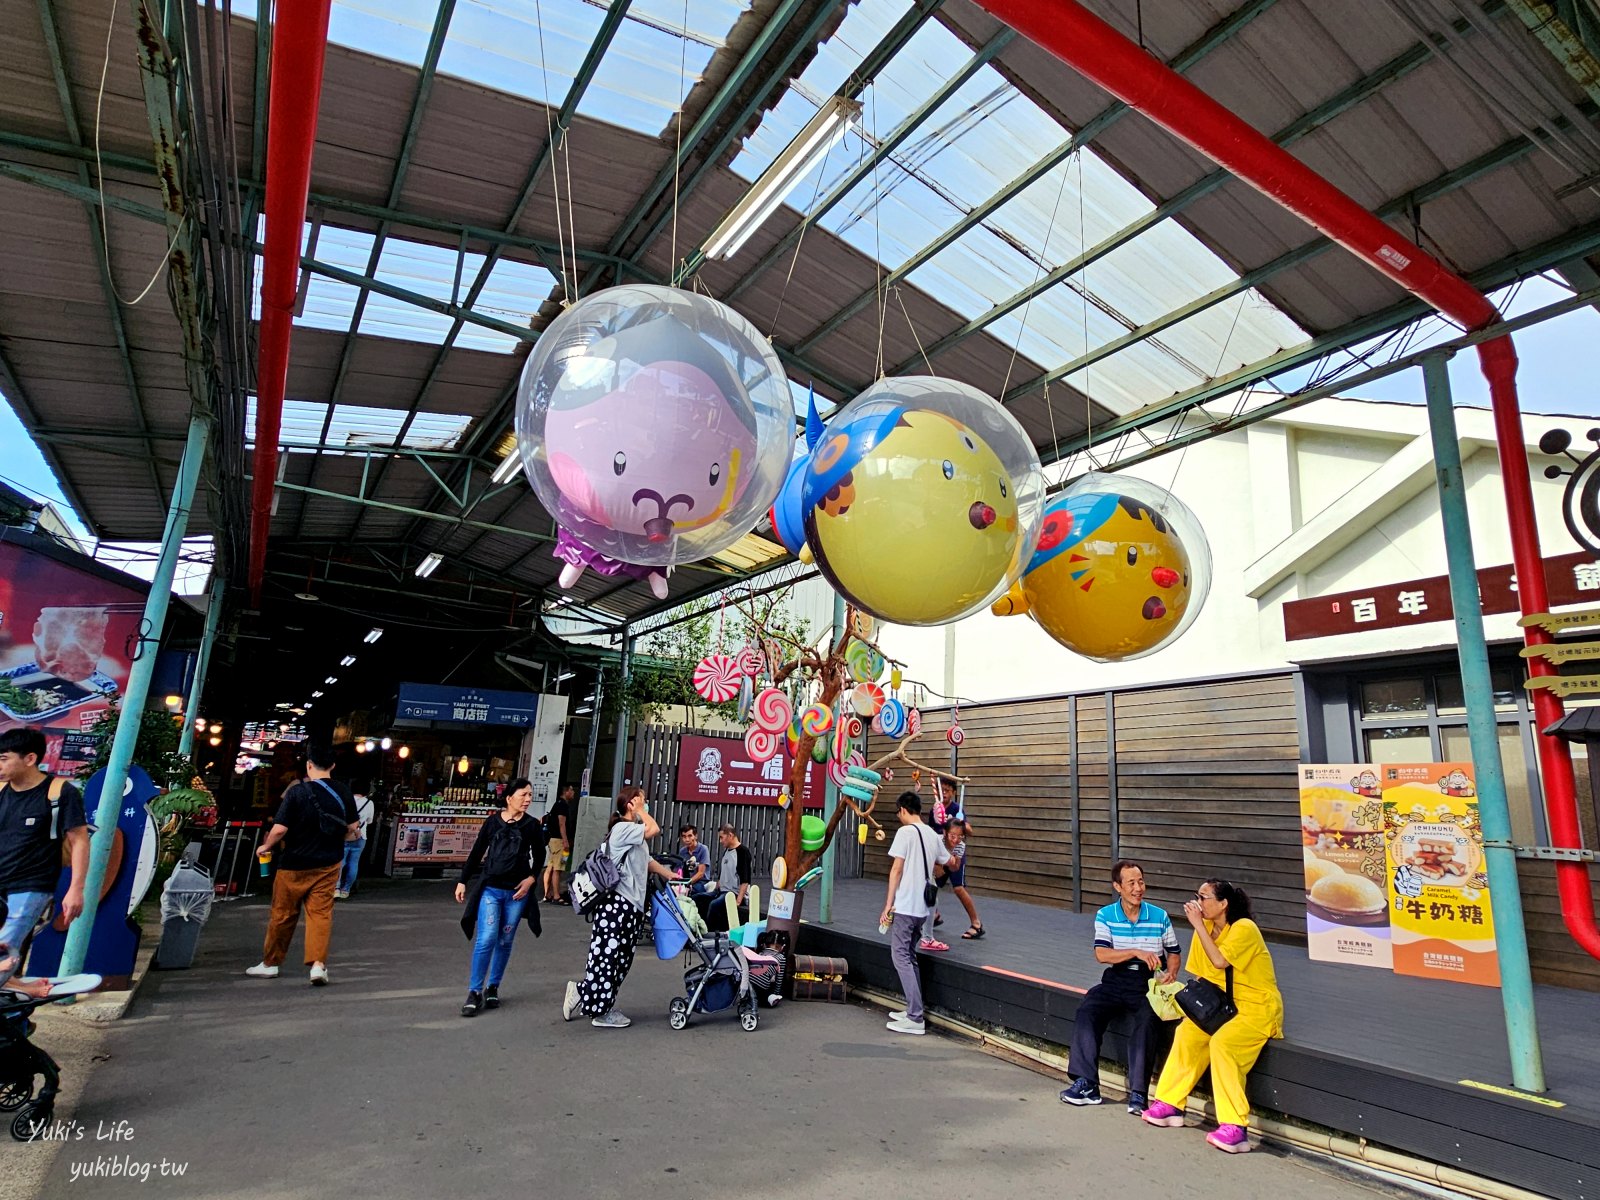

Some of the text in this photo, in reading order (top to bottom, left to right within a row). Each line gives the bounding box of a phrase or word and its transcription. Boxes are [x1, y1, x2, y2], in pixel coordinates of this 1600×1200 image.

[453, 708, 488, 721] 商店街
[728, 785, 778, 797] 台灣經典糕餅
[1406, 899, 1484, 925] 牛奶糖
